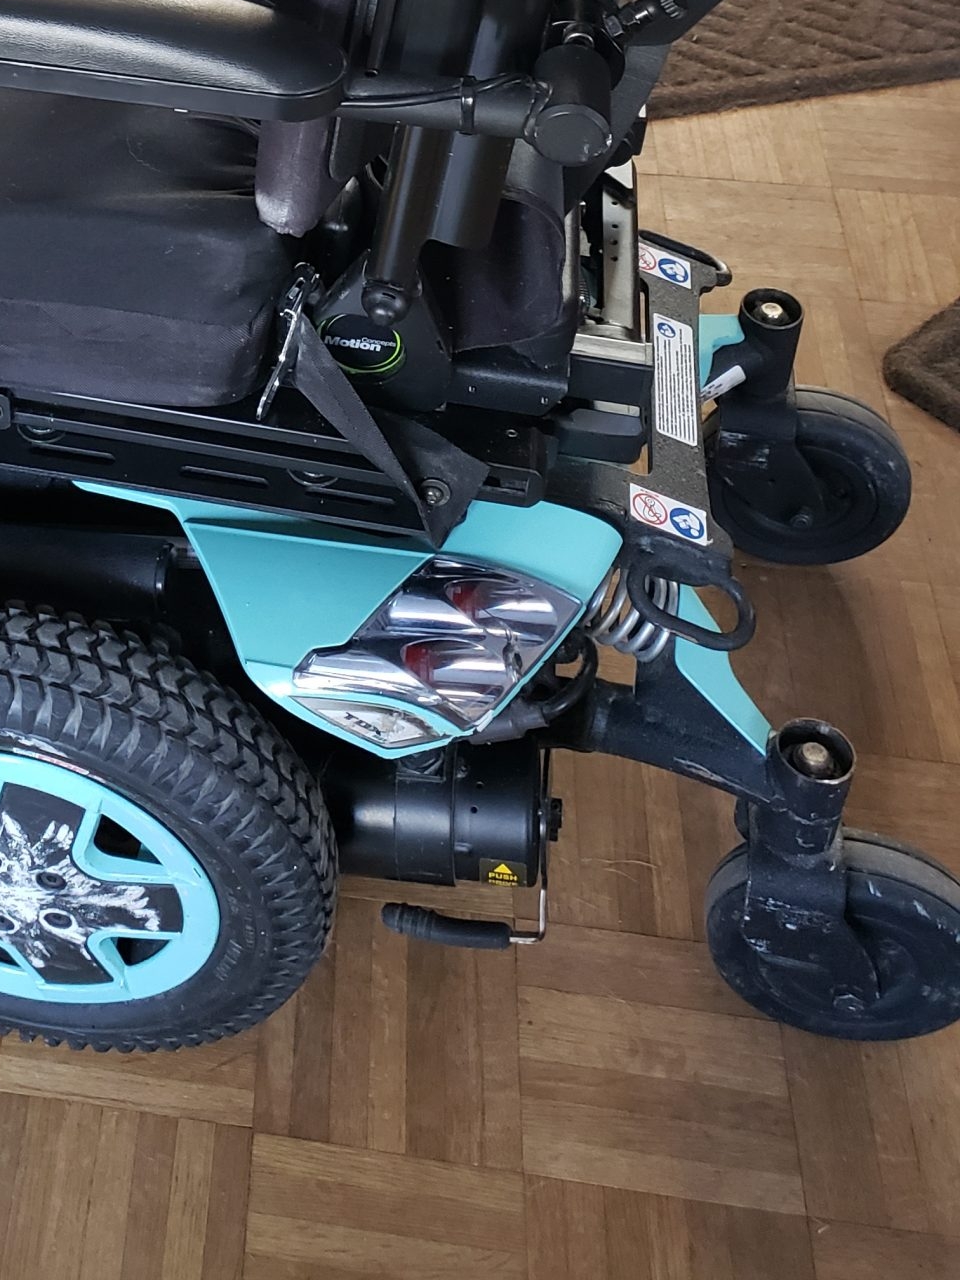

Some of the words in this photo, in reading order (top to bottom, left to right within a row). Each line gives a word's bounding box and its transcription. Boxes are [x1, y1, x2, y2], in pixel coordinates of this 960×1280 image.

[324, 335, 381, 352] Motion
[361, 337, 396, 347] Concepts
[488, 871, 517, 881] PUSH
